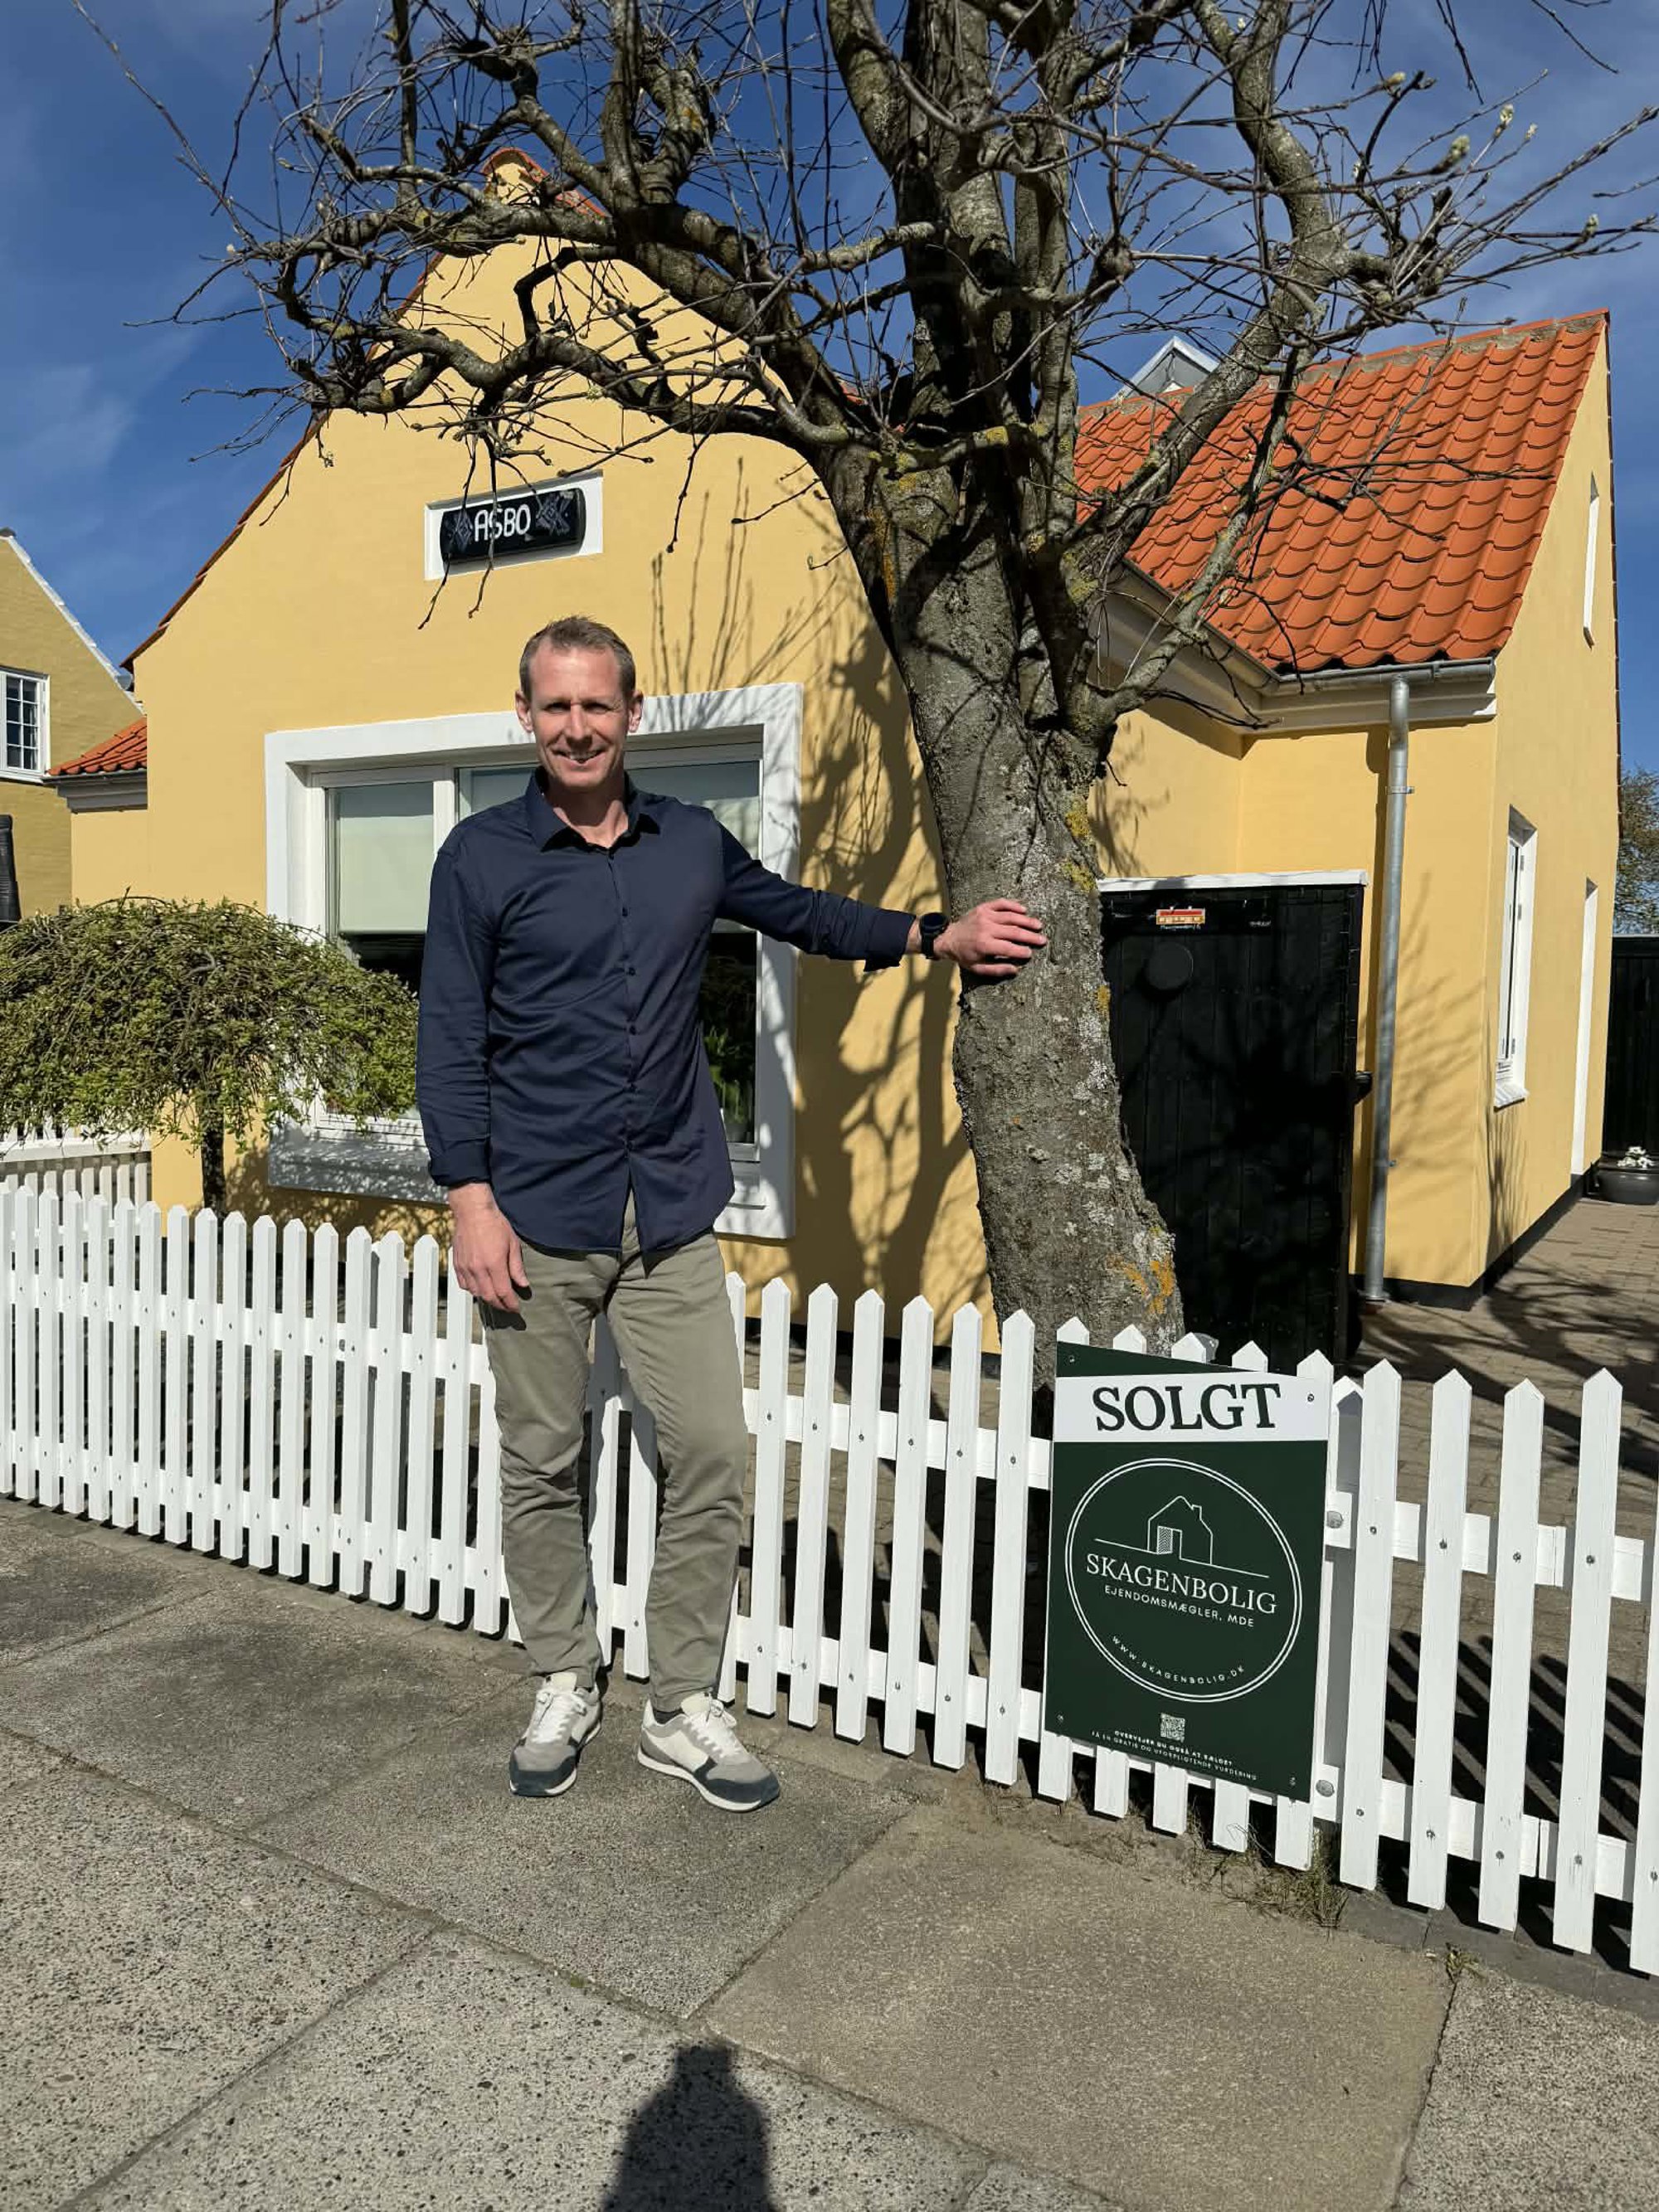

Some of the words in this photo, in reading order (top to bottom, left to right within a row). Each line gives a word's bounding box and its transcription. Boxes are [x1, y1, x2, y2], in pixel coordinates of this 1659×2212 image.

[1092, 1383, 1282, 1432] SOLGT
[1086, 1553, 1277, 1614] SKAGENBOLIG
[1104, 1585, 1223, 1621] EJENDOMSMÆGLER,
[1228, 1615, 1255, 1627] MDE
